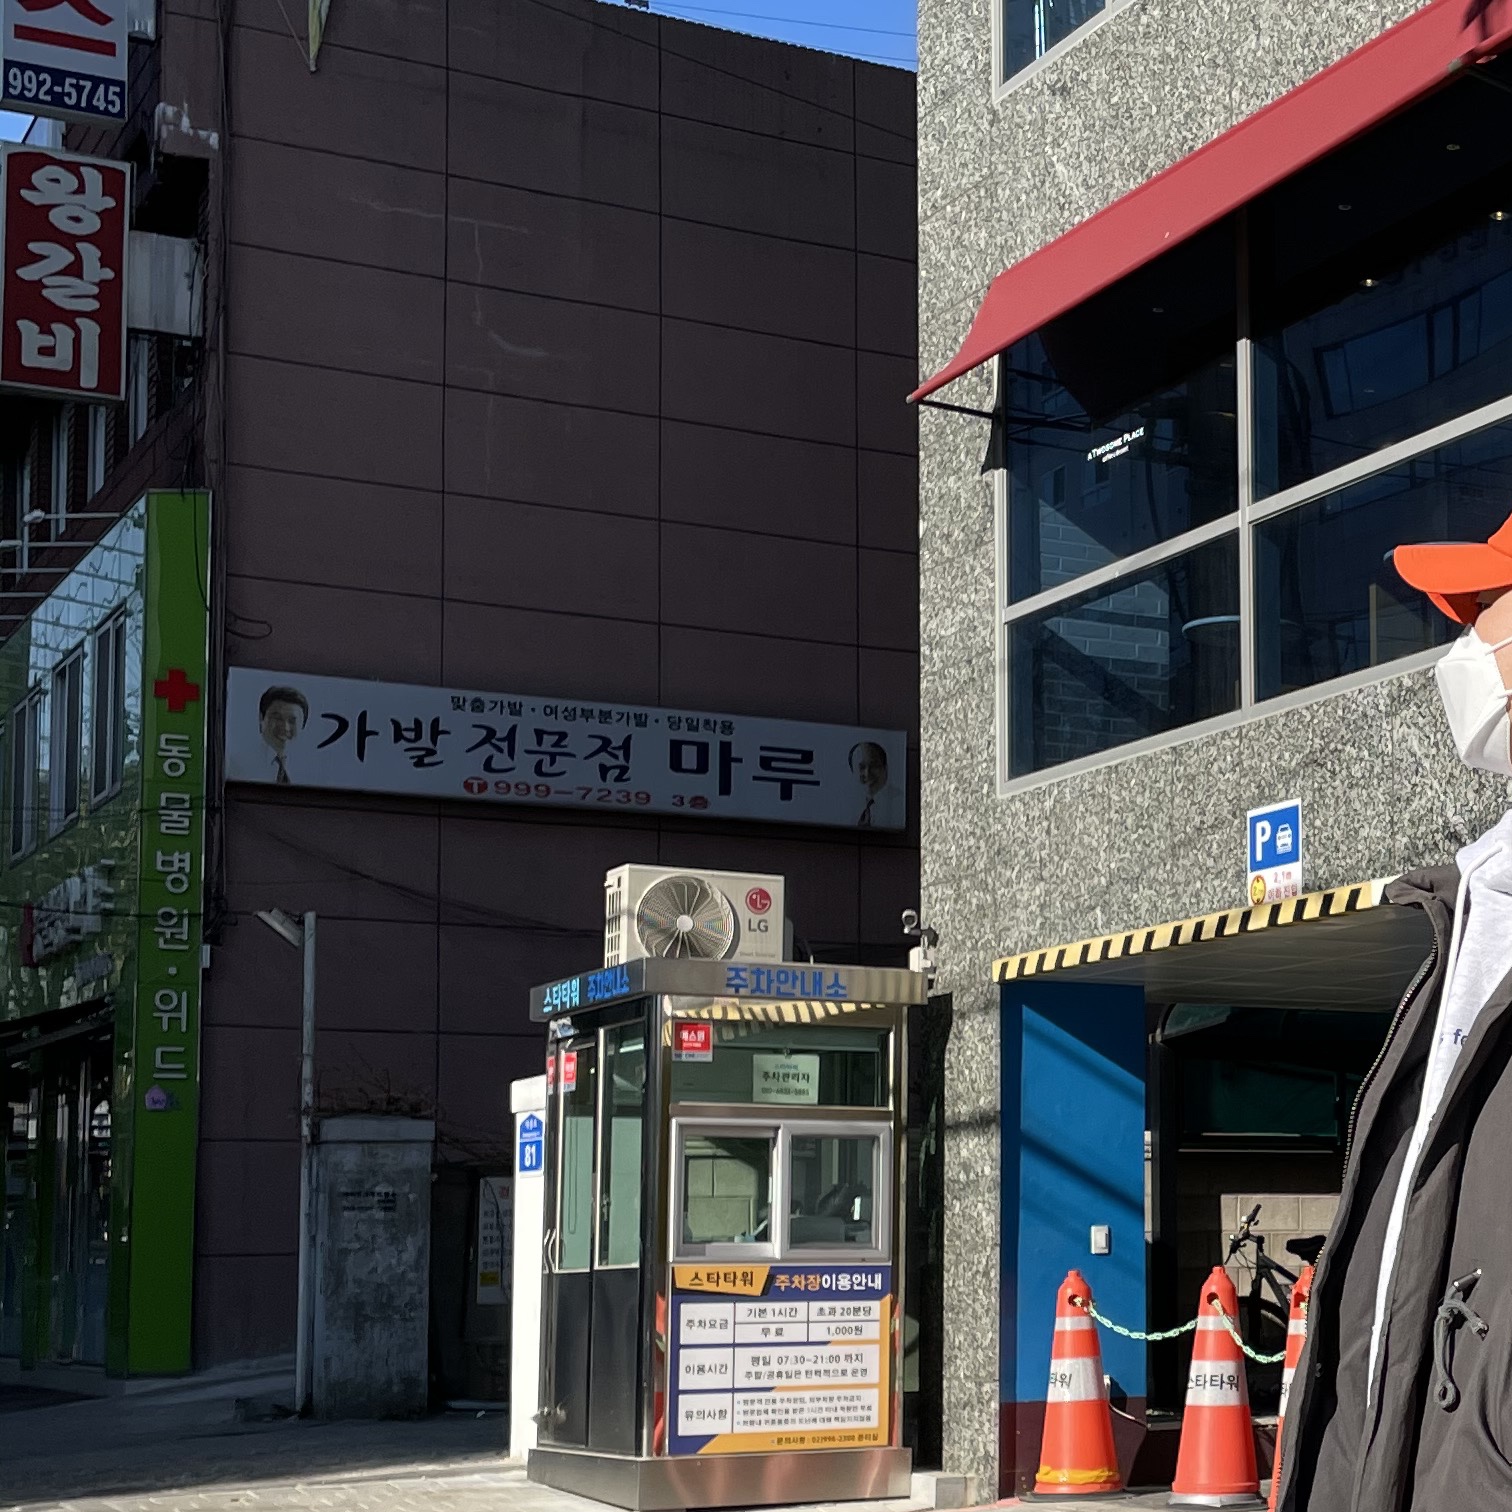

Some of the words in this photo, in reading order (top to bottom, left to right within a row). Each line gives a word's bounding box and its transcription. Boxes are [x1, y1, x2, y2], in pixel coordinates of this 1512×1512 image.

[8, 67, 121, 114] 992-5745
[16, 164, 116, 389] 왕갈비
[668, 738, 821, 802] 마루
[1255, 820, 1272, 862] P
[748, 918, 769, 933] LG
[542, 976, 581, 1013] 스타타워
[725, 967, 849, 999] 주차안내소
[524, 1144, 536, 1168] 81
[688, 1271, 754, 1288] 스타타워
[771, 1306, 798, 1318] 1시간
[826, 1325, 863, 1336] 1,000원
[685, 1363, 728, 1376] 이용시간
